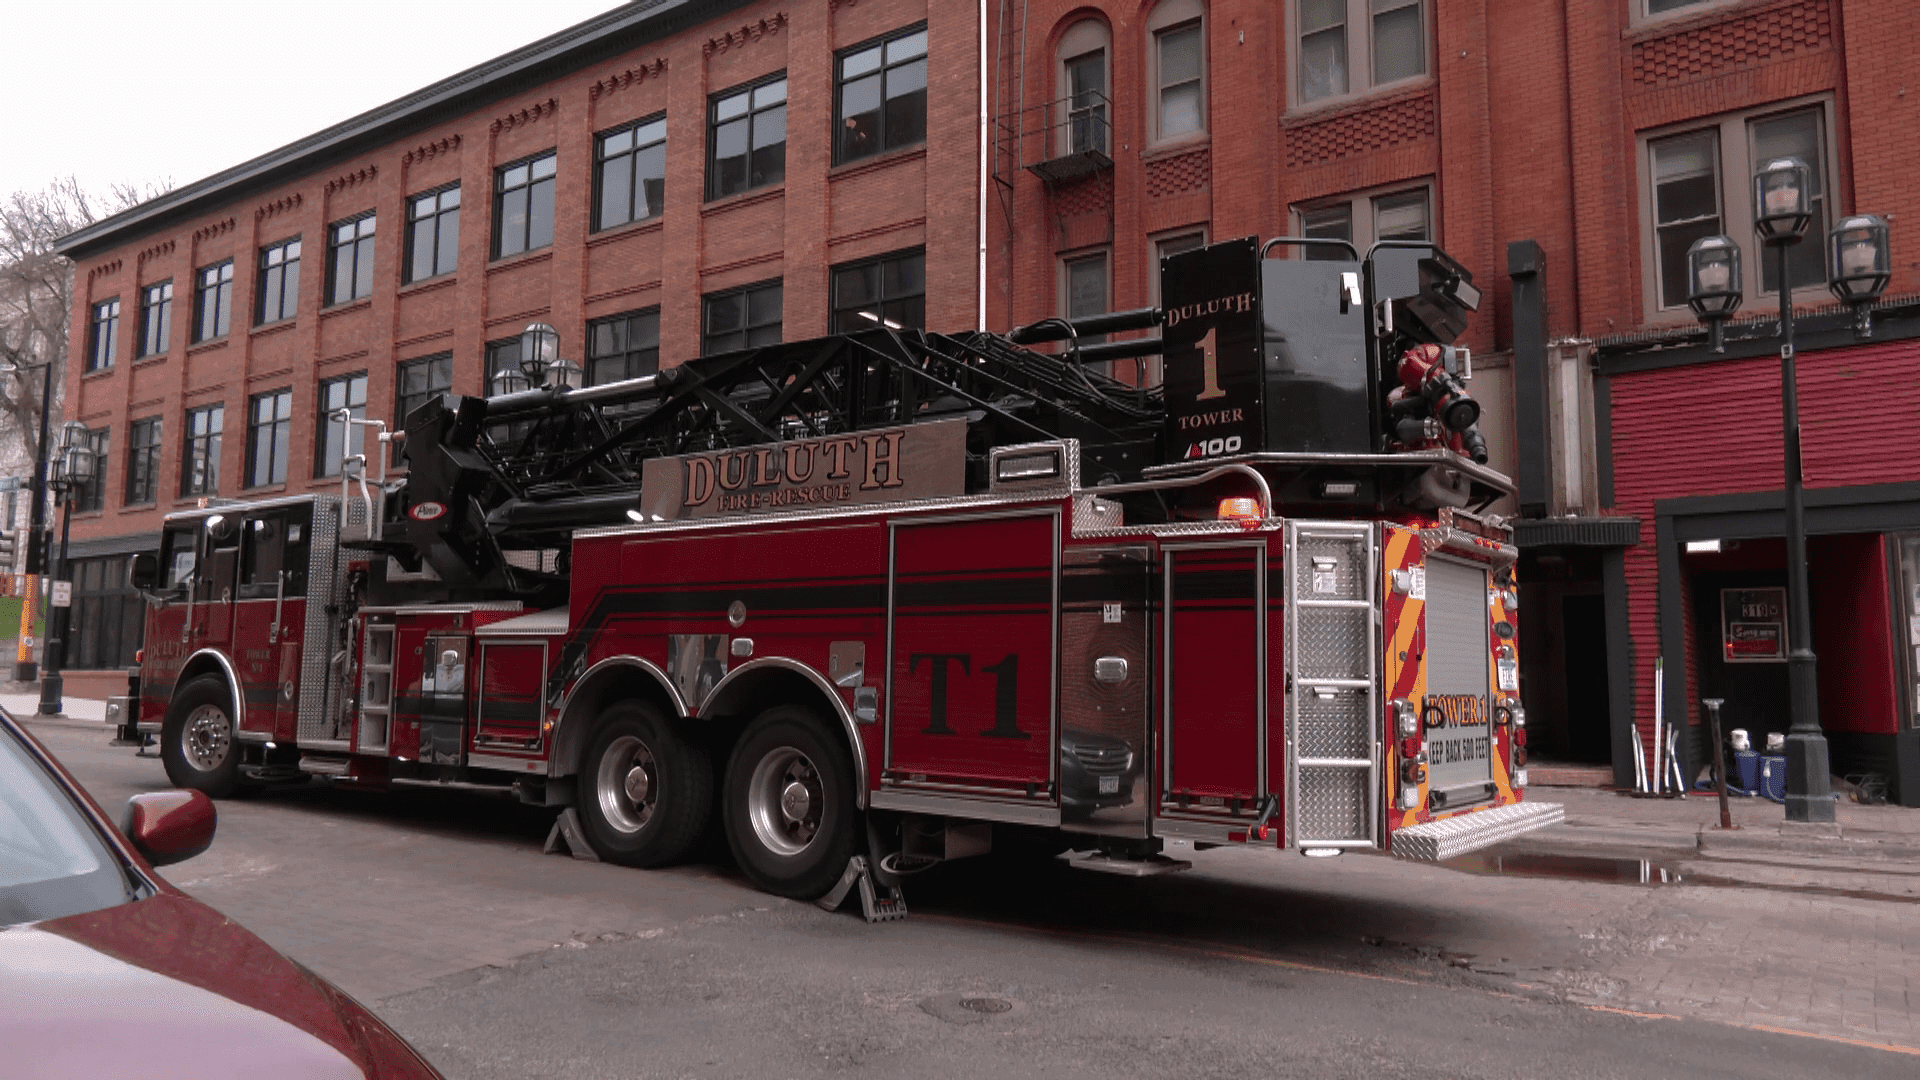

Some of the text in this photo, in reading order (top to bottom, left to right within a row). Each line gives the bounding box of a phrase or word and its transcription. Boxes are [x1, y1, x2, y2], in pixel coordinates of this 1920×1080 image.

[1167, 292, 1252, 328] DULUTH
[1194, 327, 1227, 402] 1
[1178, 408, 1244, 430] TOWER
[683, 431, 905, 506] DULUTH
[717, 484, 850, 512] FIRE-RESCUE
[909, 652, 1033, 740] T1
[1428, 693, 1488, 729] TOWER 1
[1446, 739, 1462, 763] BACK
[1463, 737, 1474, 761] 500
